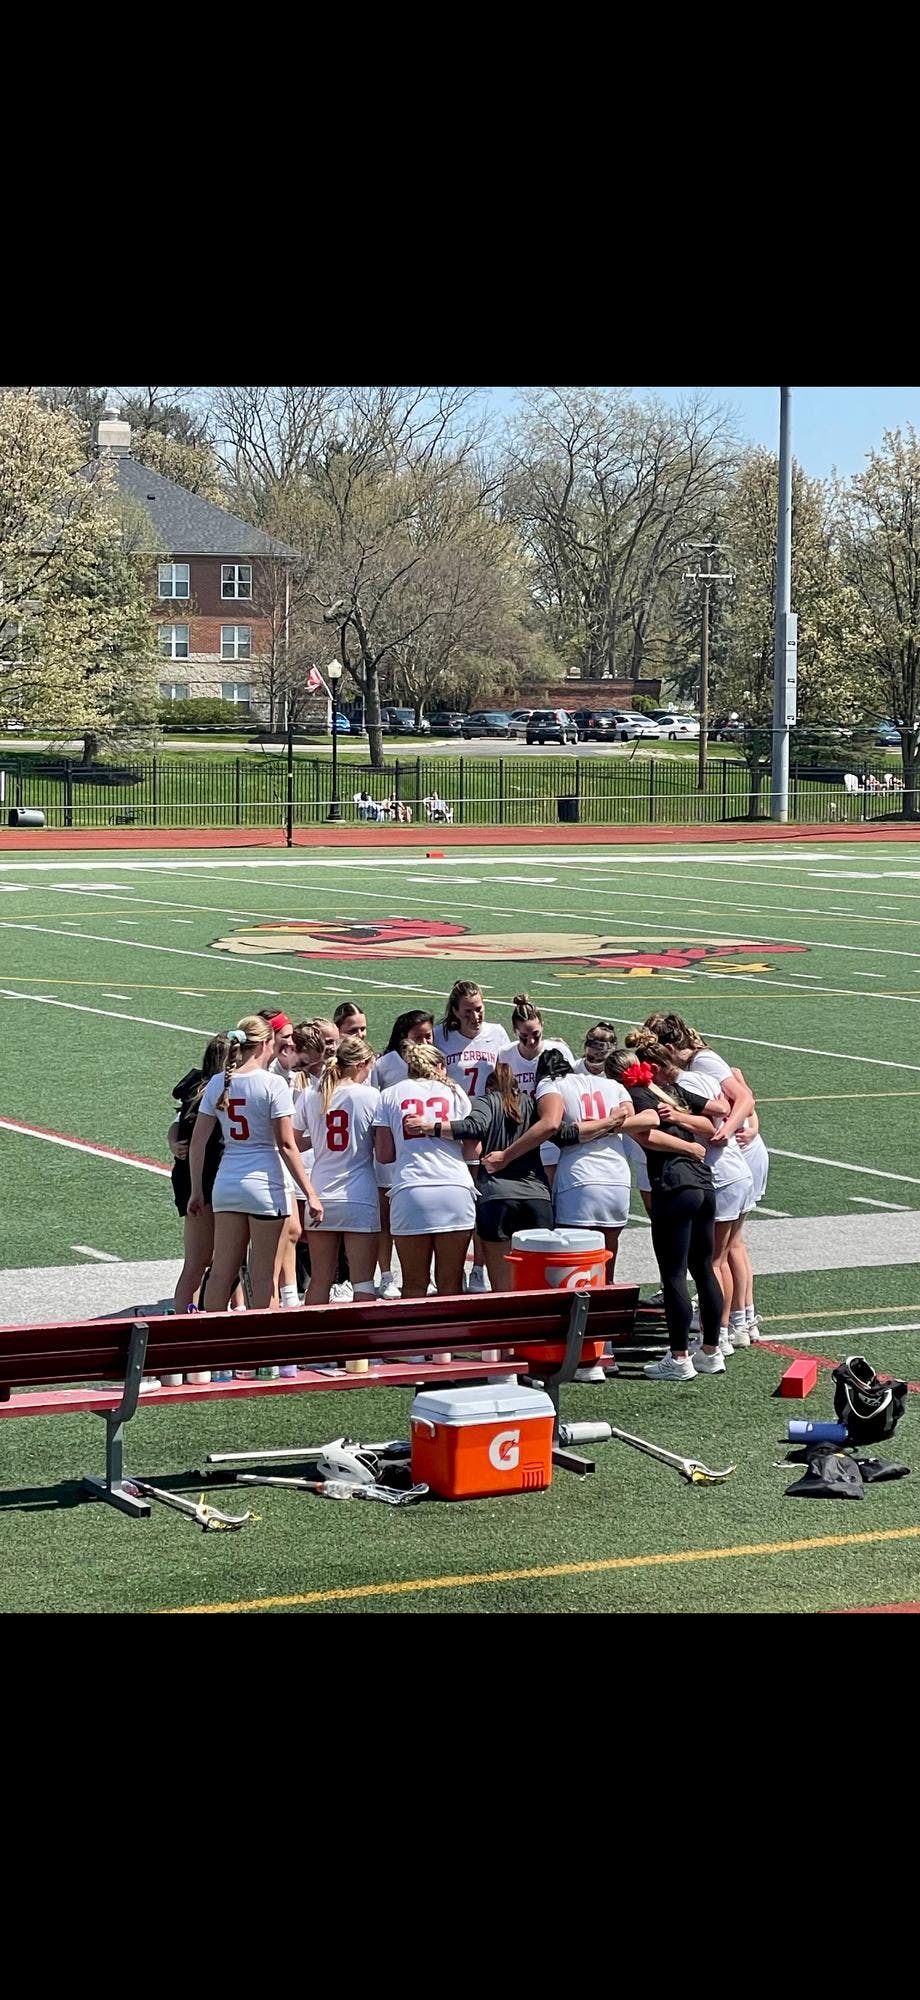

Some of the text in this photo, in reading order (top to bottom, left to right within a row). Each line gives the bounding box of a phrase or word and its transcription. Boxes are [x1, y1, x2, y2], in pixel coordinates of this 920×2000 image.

[446, 1051, 496, 1065] OTTERBEIN
[464, 1067, 479, 1096] 7
[227, 1099, 250, 1140] 5
[580, 1091, 607, 1120] 11
[326, 1110, 349, 1152] 8
[489, 1429, 521, 1471] G
